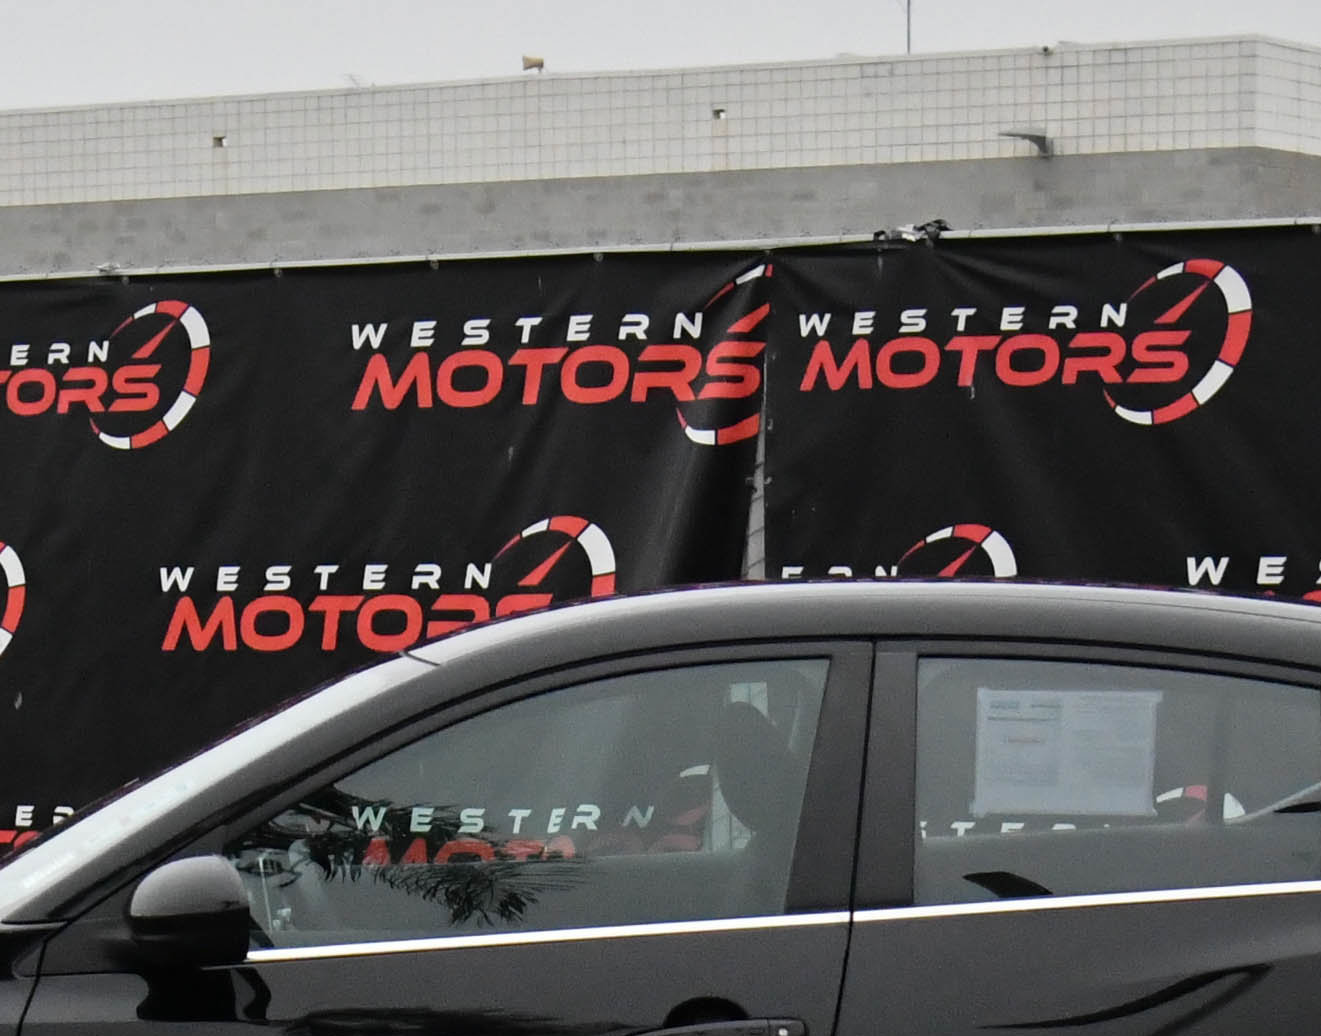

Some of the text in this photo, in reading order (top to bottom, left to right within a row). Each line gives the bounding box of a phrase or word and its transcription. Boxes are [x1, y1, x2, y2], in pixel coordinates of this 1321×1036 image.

[352, 313, 702, 349] WESTERN
[799, 303, 1127, 335] WESTERN
[352, 343, 761, 409] MOTORS
[800, 332, 1188, 389] MOTORS
[160, 563, 492, 592] WESTERN
[352, 804, 655, 834] WESTERN
